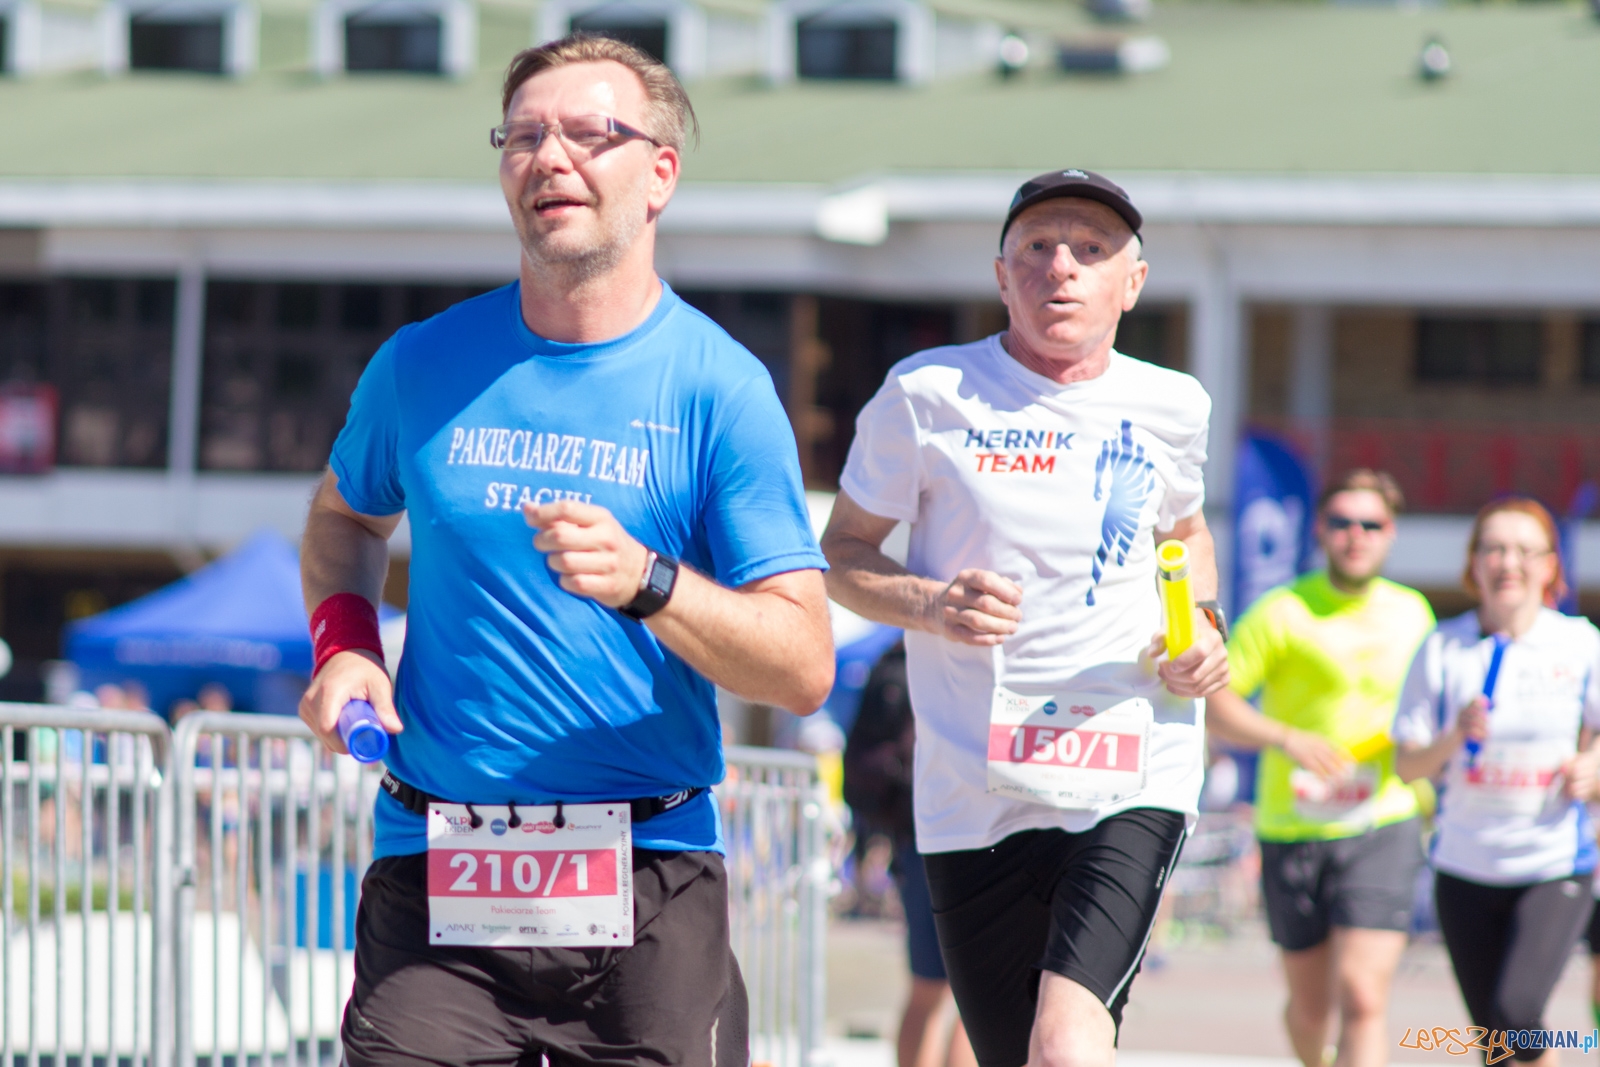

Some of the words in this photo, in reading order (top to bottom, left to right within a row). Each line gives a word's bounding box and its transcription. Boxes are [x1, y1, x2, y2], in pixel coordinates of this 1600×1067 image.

[964, 428, 1076, 450] HERNIK
[447, 427, 586, 476] PAKIECIARZE
[588, 439, 650, 488] TEAM
[975, 453, 1056, 474] TEAM
[1009, 726, 1119, 768] 150/1
[449, 852, 589, 897] 210/1
[491, 905, 533, 915] Pakieciarze
[536, 906, 556, 915] Team
